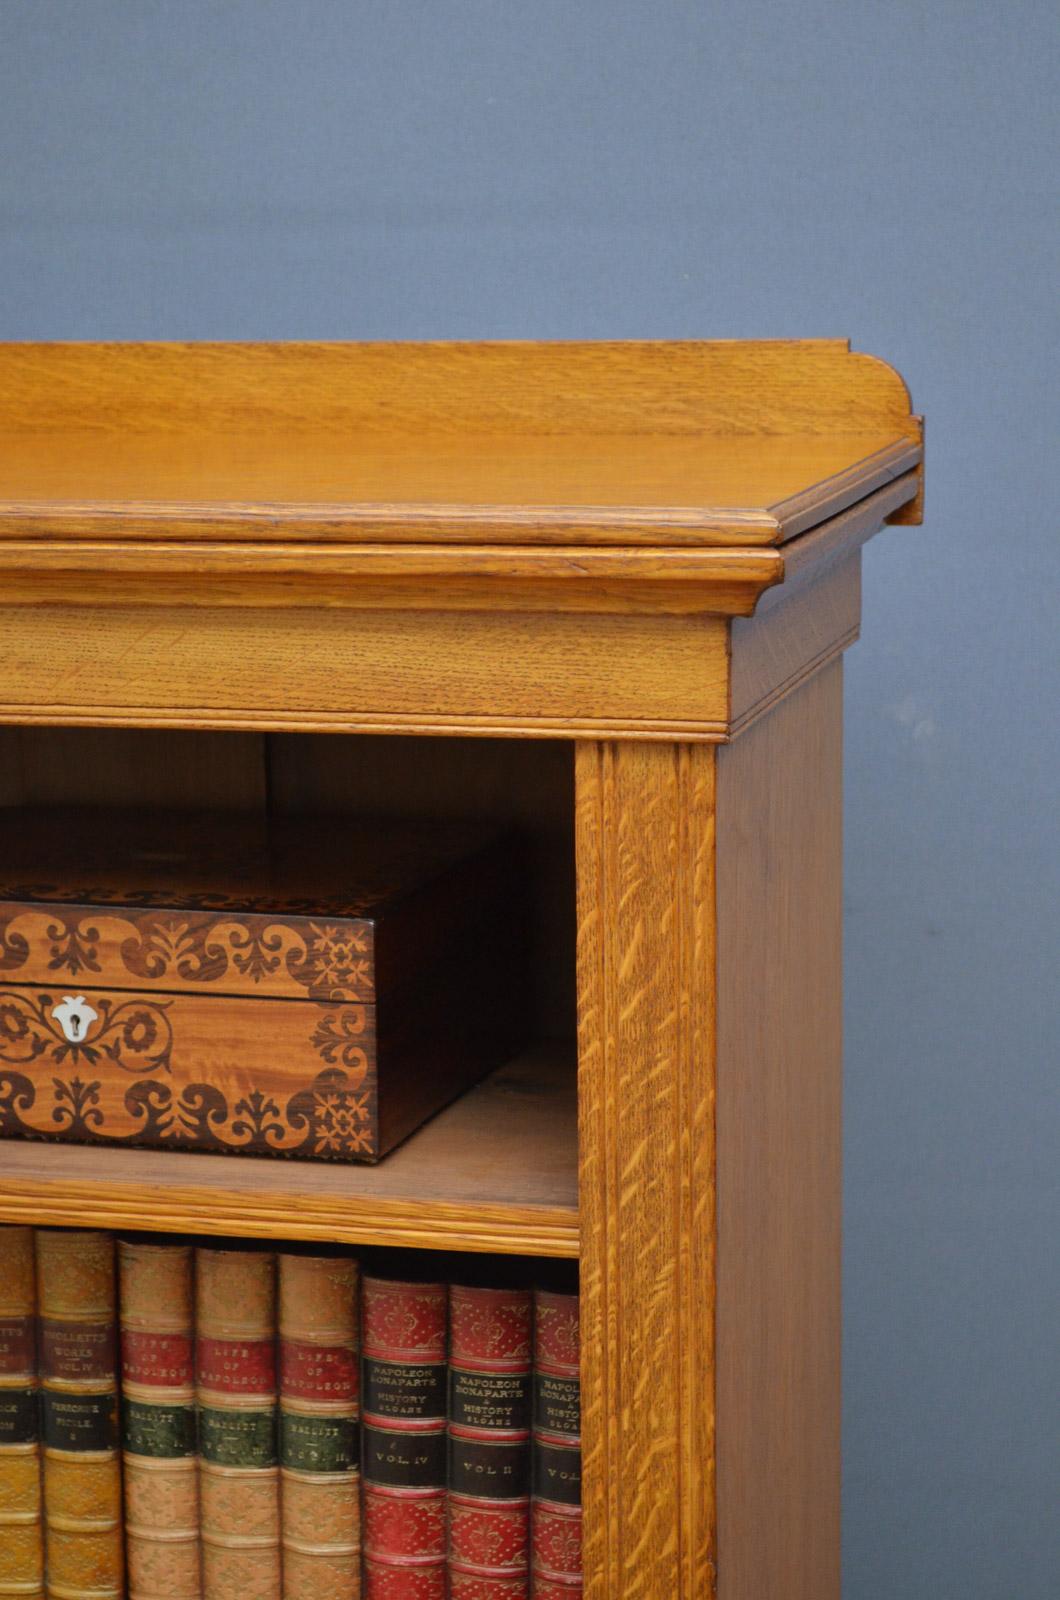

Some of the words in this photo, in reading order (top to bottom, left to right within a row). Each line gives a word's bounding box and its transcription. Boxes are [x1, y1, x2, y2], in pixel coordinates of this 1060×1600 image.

[131, 1338, 169, 1349] LIFE
[141, 1353, 158, 1361] OF
[214, 1348, 249, 1358] LIFE
[297, 1352, 334, 1362] LIFE
[124, 1362, 187, 1377] NAPOLEON
[223, 1362, 240, 1371] OF
[306, 1367, 323, 1377] OF
[374, 1366, 433, 1378] NAPOLEON
[200, 1371, 267, 1385] NAPOLEON
[284, 1376, 351, 1391] NAPOLEON
[370, 1375, 437, 1387] BONAPARTE
[460, 1376, 521, 1389] NAPOLEON
[455, 1384, 524, 1398] BONAPARTE
[377, 1393, 427, 1404] HISTORY
[379, 1404, 422, 1414] SLOANE
[463, 1403, 513, 1416] HISTORY
[466, 1415, 512, 1426] SLOANE
[415, 1456, 428, 1464] IV
[463, 1462, 496, 1475] VOL
[503, 1466, 512, 1475] II
